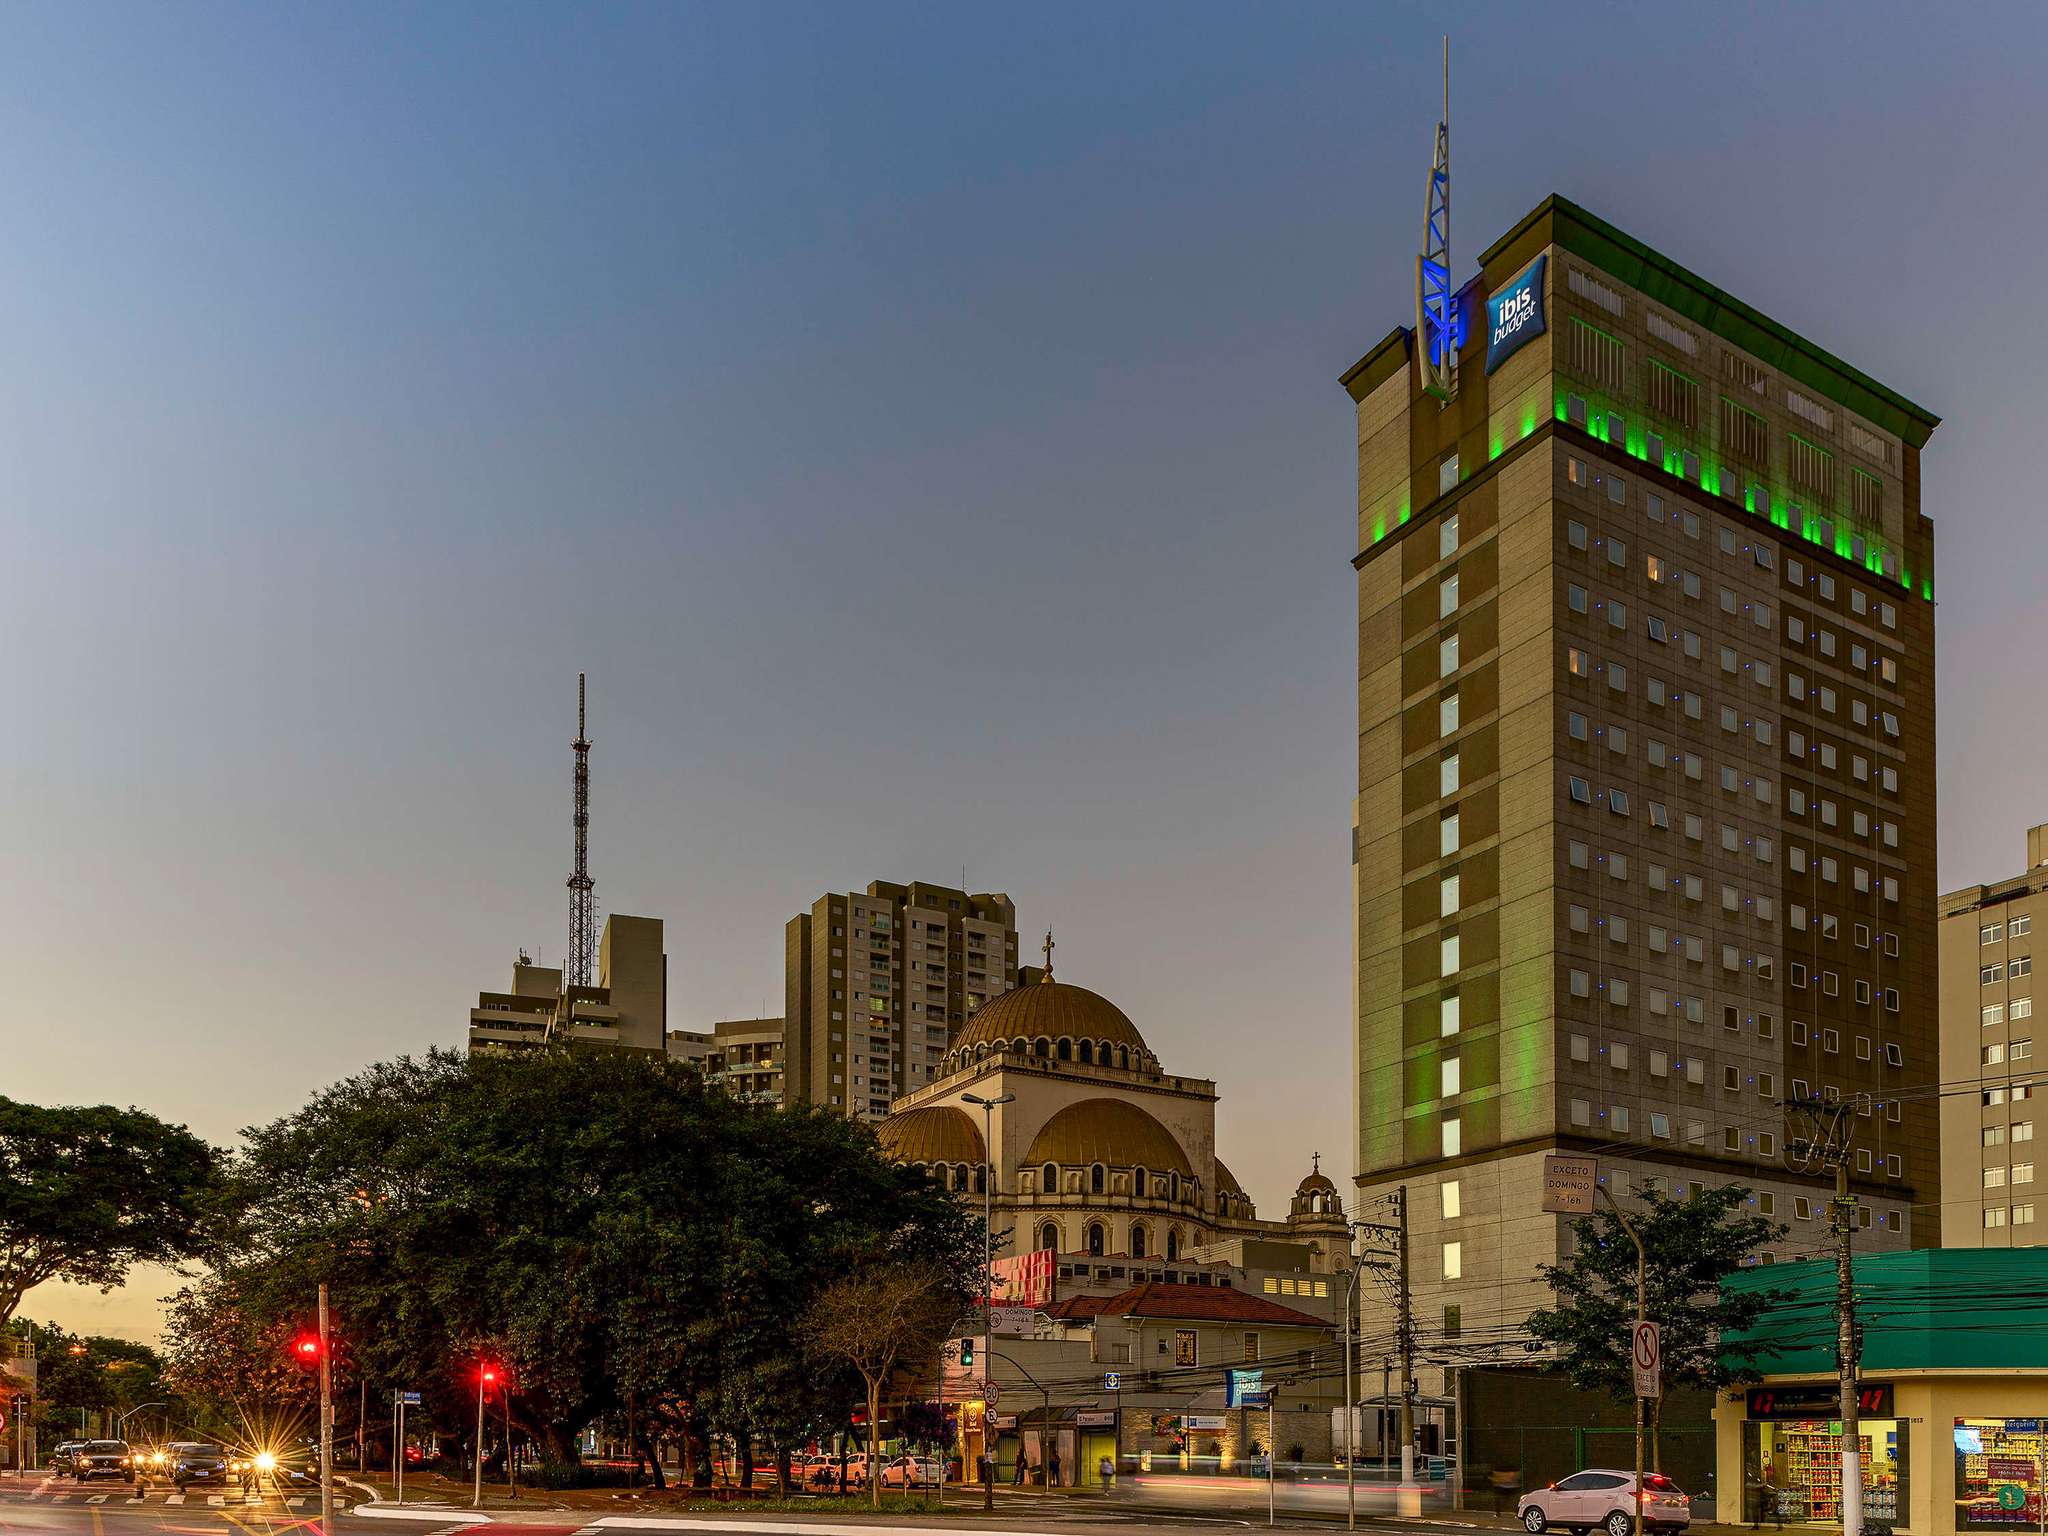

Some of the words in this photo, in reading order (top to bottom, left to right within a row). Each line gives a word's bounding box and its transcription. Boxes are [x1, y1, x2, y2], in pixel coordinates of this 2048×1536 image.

[1499, 287, 1531, 326] ibis
[1493, 300, 1537, 346] budget
[1553, 1165, 1589, 1176] EXCETO
[1549, 1180, 1590, 1190] DOMINGO
[1006, 1308, 1032, 1316] DOMINGO
[1636, 1373, 1656, 1383] EXCETO
[986, 1386, 997, 1399] 50
